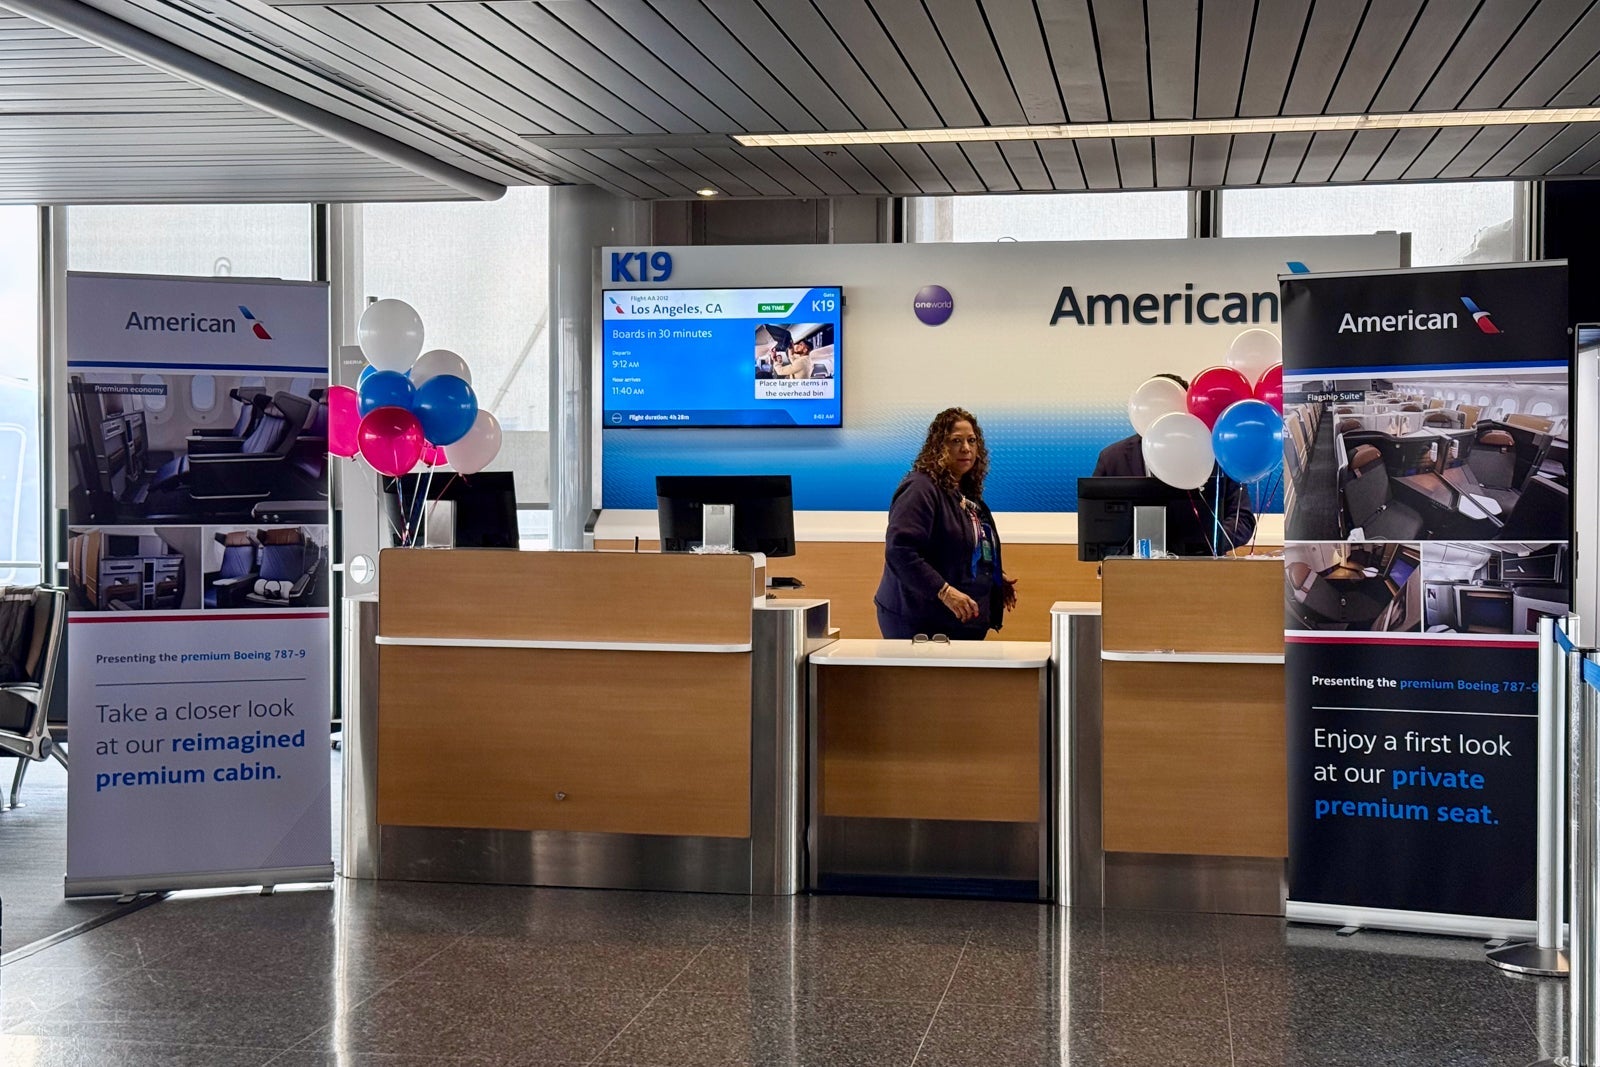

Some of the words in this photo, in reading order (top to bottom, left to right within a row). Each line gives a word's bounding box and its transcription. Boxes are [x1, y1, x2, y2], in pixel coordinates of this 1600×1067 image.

[611, 251, 672, 282] K19
[631, 305, 650, 314] Los
[653, 304, 702, 317] Angeles,
[706, 303, 723, 314] CA
[812, 300, 834, 312] K19
[1050, 283, 1278, 325] American
[125, 311, 235, 333] American
[1338, 309, 1458, 334] American
[612, 329, 646, 339] Boards
[648, 329, 656, 338] in
[659, 329, 670, 338] 30
[673, 329, 712, 338] minutes
[612, 360, 628, 368] 9:12
[612, 387, 632, 395] 11:40
[1307, 394, 1338, 402] Flagship
[96, 653, 156, 665] Presenting
[159, 652, 178, 662] the
[181, 652, 230, 664] premium
[234, 650, 271, 661] Boeing
[275, 649, 306, 659] 787-9
[1312, 676, 1375, 690] Presenting
[1377, 677, 1397, 688] the
[1400, 678, 1454, 691] premium
[1458, 680, 1499, 694] Boeing
[1502, 681, 1539, 693] 787-9
[96, 703, 147, 723] Take
[155, 707, 168, 721] a
[175, 702, 242, 720] closer
[249, 698, 294, 718] look
[96, 738, 118, 755] at
[126, 738, 164, 754] our
[172, 730, 305, 753] reimagined
[1314, 728, 1376, 754] Enjoy
[1384, 734, 1397, 751] a
[1405, 731, 1451, 754] first
[1459, 734, 1512, 757] look
[96, 766, 204, 792] premium
[213, 762, 282, 782] cabin.
[1313, 763, 1337, 782] at
[1344, 767, 1385, 784] our
[1392, 766, 1485, 790] private
[1315, 798, 1429, 821] premium
[1437, 804, 1499, 825] seat.
